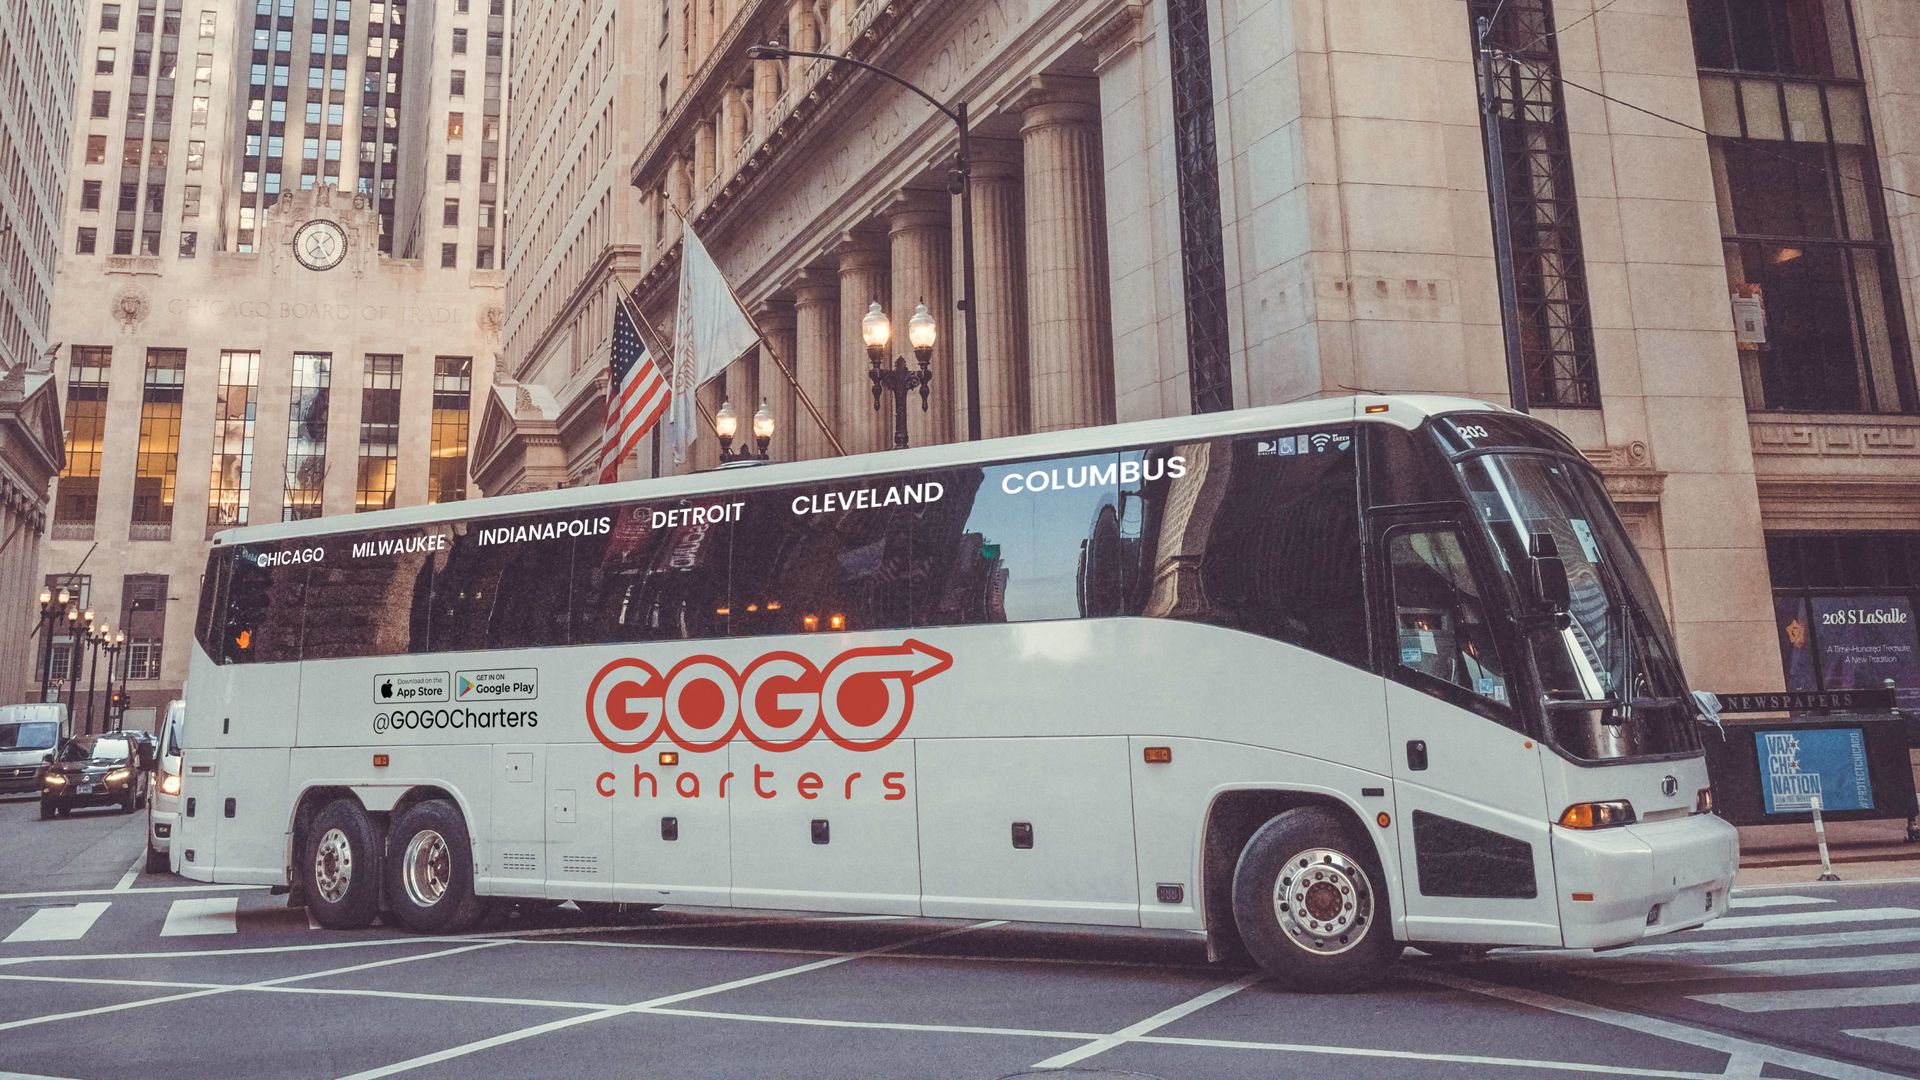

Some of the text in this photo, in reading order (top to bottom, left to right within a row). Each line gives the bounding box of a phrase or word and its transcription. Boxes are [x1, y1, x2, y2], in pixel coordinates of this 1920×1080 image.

[279, 302, 351, 320] BOARD
[361, 304, 389, 321] OF
[399, 306, 463, 324] TRADE
[1457, 425, 1488, 439] 203
[1001, 455, 1187, 495] COLUMBUS
[791, 481, 944, 516] CLEVELAND
[651, 502, 745, 530] DETROIT
[478, 516, 611, 546] INDIANAPOLIS
[352, 534, 446, 558] MILWAUKEE
[257, 547, 325, 568] CHICAGO
[1822, 607, 1907, 625] 208 S LaSalle
[397, 678, 424, 686] Download
[496, 673, 505, 681] ON
[397, 686, 443, 699] App Store
[476, 682, 535, 695] Google Play
[586, 638, 953, 754] GOGO
[1728, 694, 1852, 710] NEWSPAPERS
[373, 708, 538, 734] @GOGOCharters
[596, 763, 906, 800] charters
[1772, 775, 1821, 794] NATION
